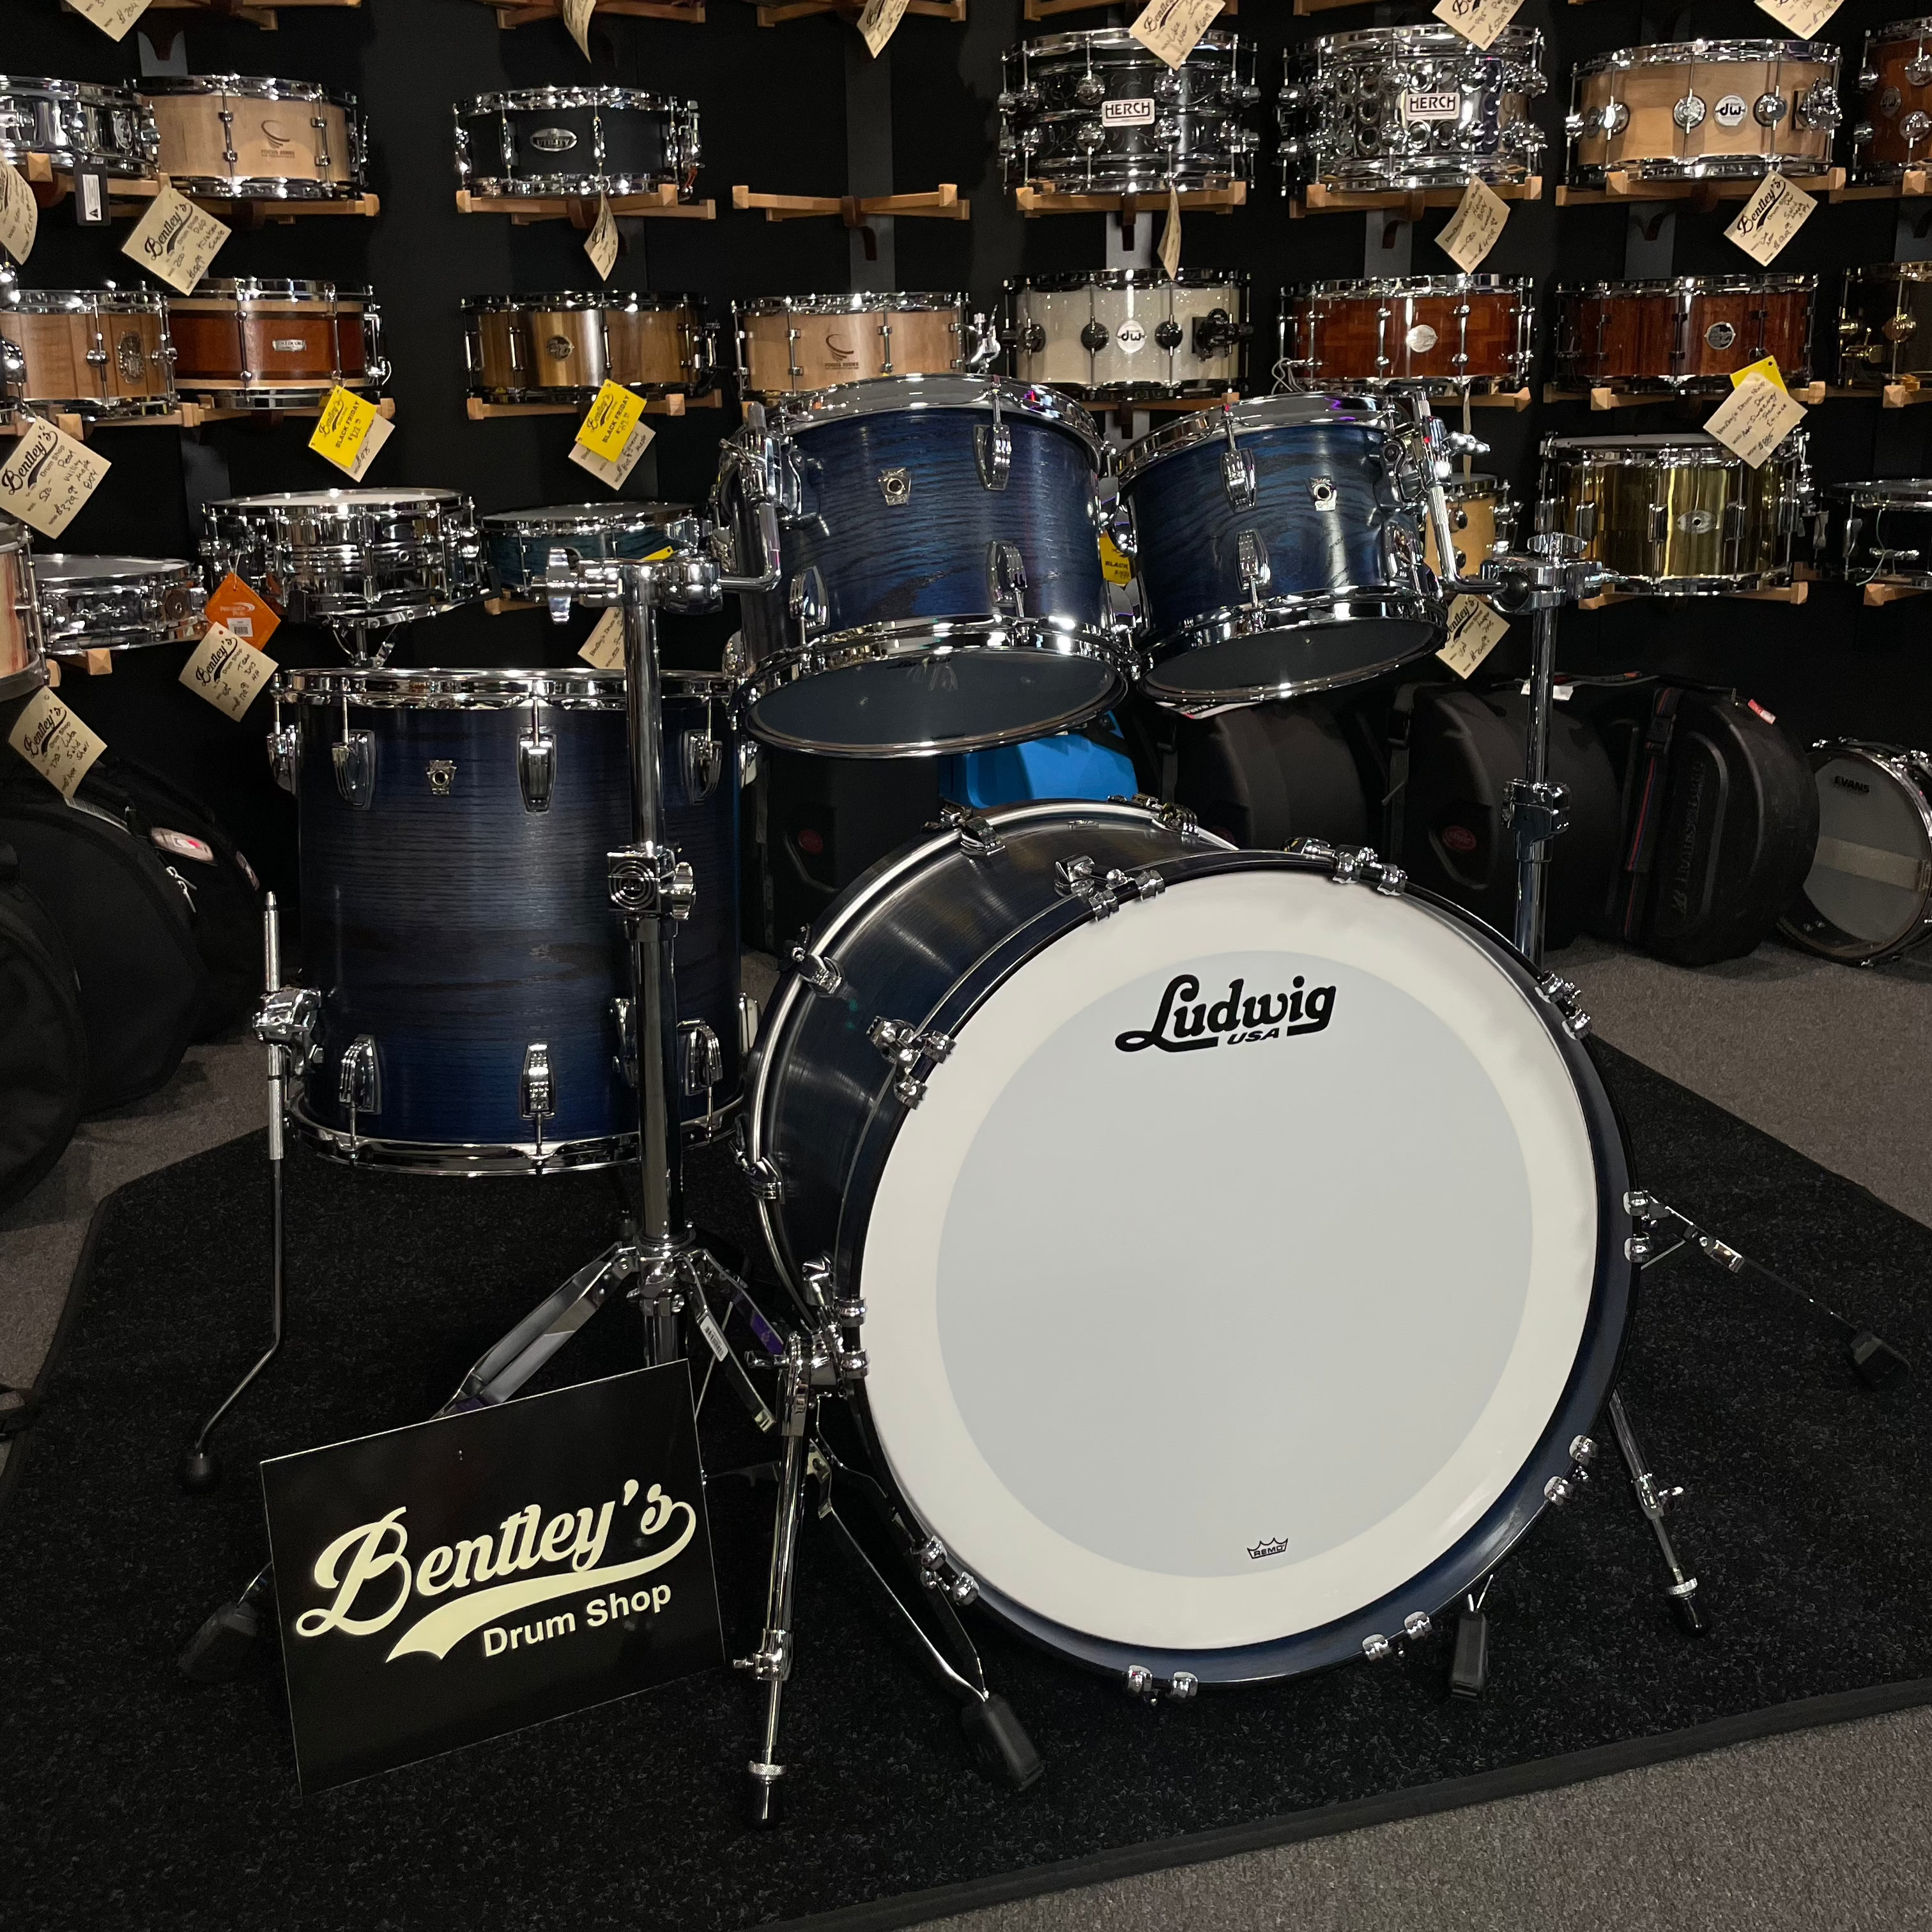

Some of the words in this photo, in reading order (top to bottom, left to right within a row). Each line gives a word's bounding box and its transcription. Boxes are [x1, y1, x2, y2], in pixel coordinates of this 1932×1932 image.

[1106, 102, 1150, 116] HERCH
[1410, 96, 1456, 110] HERCH
[1719, 103, 1742, 116] dw
[1737, 178, 1784, 237] Bentley's
[144, 203, 188, 261] Bentley's
[1121, 330, 1141, 341] dw
[335, 426, 349, 448] BLACK
[346, 401, 360, 425] FRIDAY
[602, 420, 617, 443] BLACK
[614, 395, 629, 420] FRIDAY
[1, 429, 57, 496] Bentley's
[40, 461, 54, 477] Drum
[52, 445, 65, 461] Shop
[1441, 599, 1477, 641] entley's
[195, 636, 236, 688] Bentley's
[24, 705, 65, 758] Bentley's
[1834, 776, 1870, 793] EVANS
[1115, 974, 1337, 1053] Ludwig
[1227, 1027, 1280, 1045] USA
[296, 1479, 696, 1637] Bentley's
[1254, 1545, 1283, 1557] REMO
[483, 1613, 576, 1657] Drum
[586, 1583, 672, 1628] Shop
